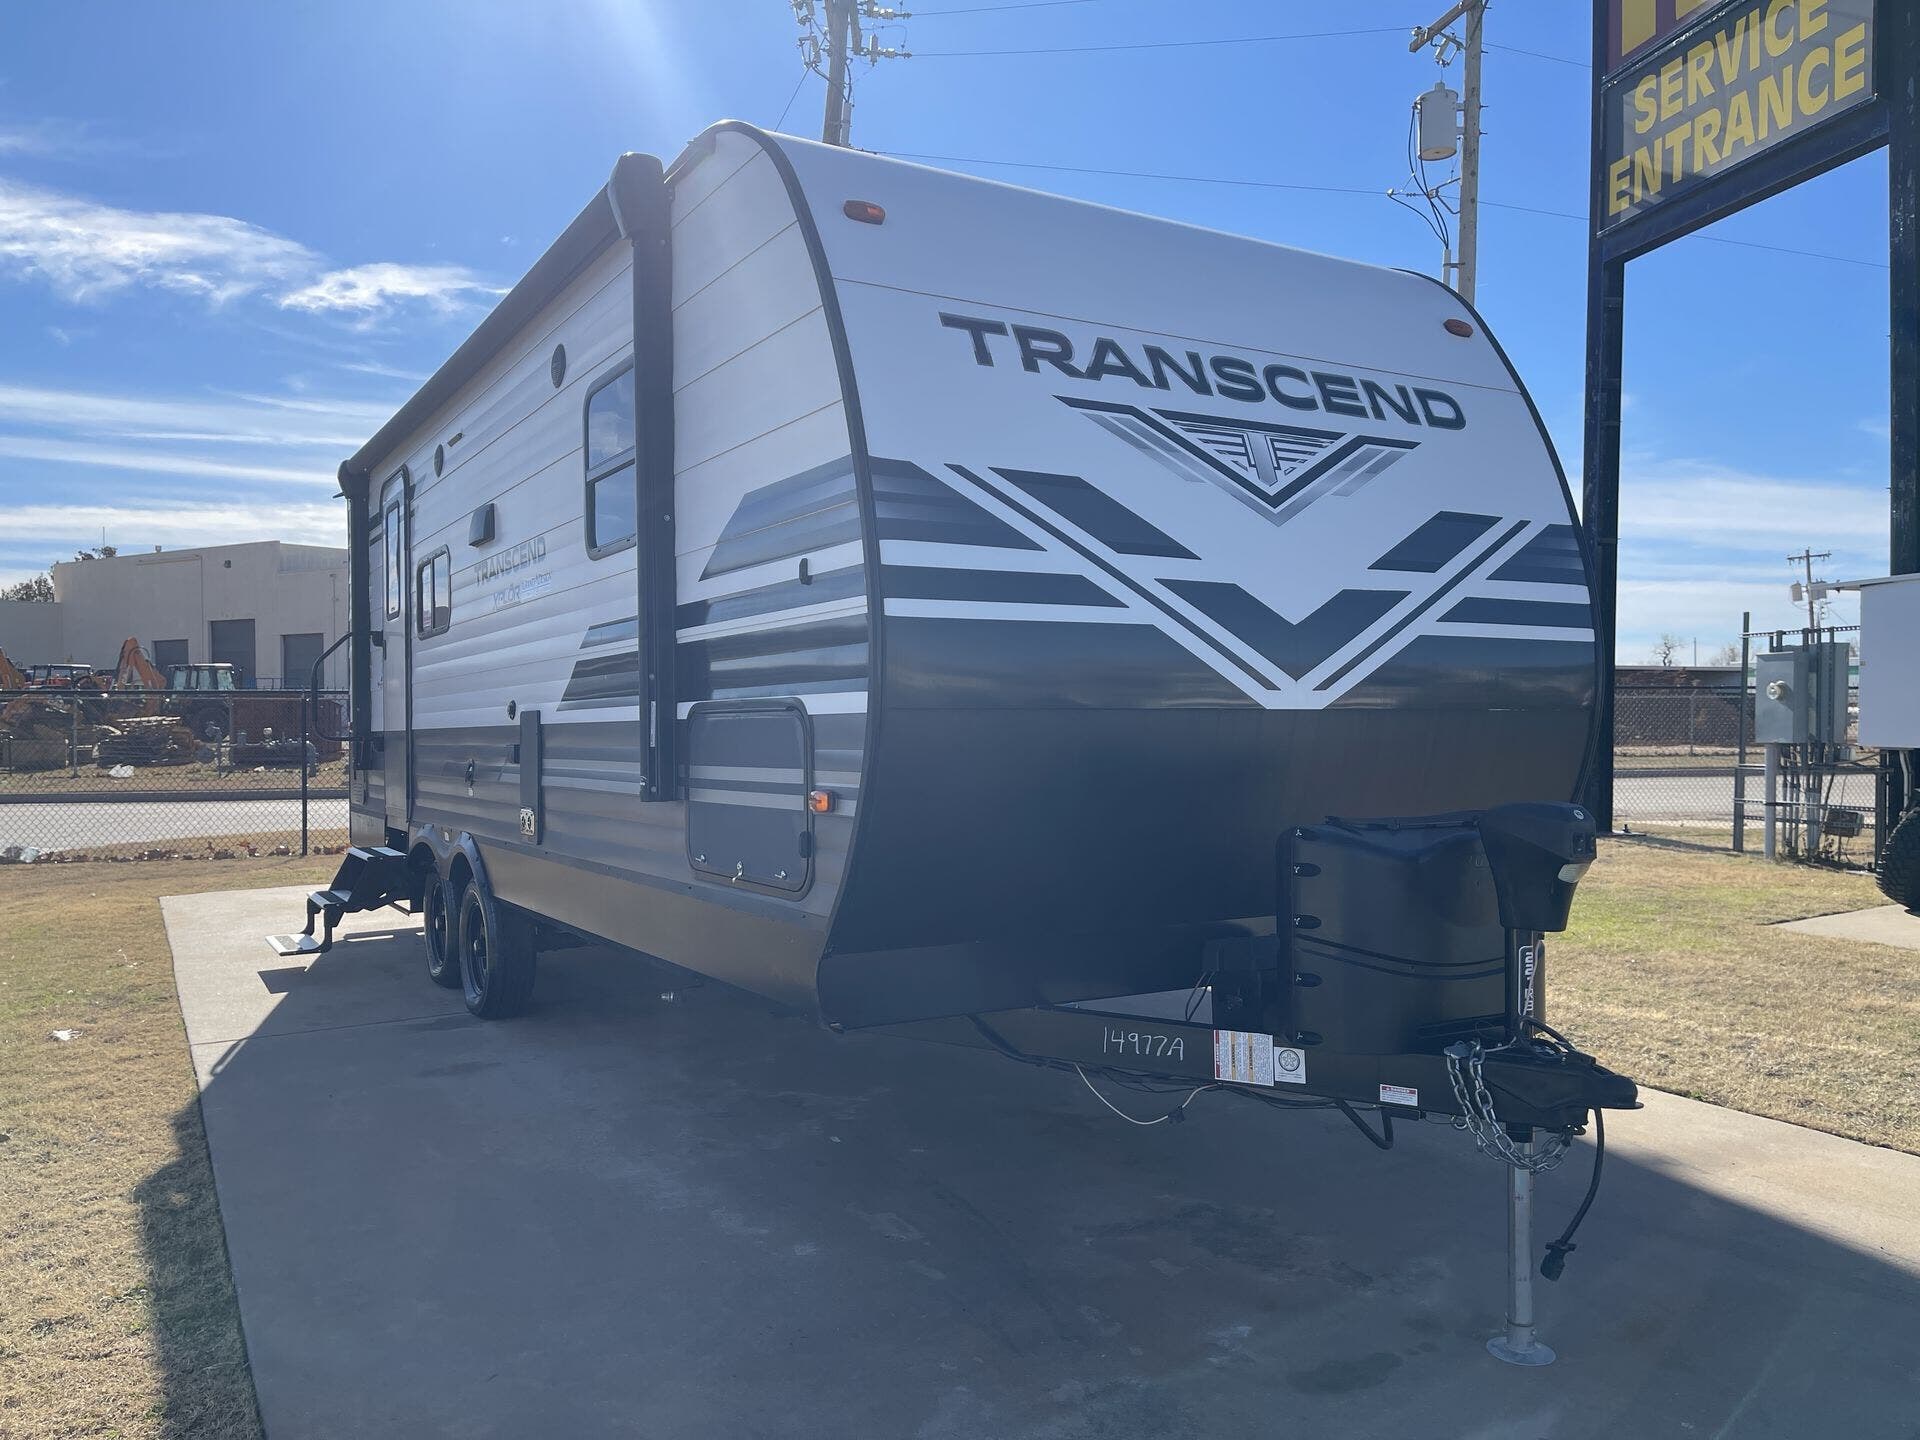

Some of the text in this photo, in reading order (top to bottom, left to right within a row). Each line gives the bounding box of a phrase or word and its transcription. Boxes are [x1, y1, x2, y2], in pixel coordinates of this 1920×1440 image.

[1608, 22, 1866, 217] ENTRANCE
[1633, 0, 1828, 134] SERVICE
[938, 311, 1466, 431] TRANSCEND
[474, 536, 546, 586] TRANSCEND
[1102, 1025, 1184, 1062] 14977A
